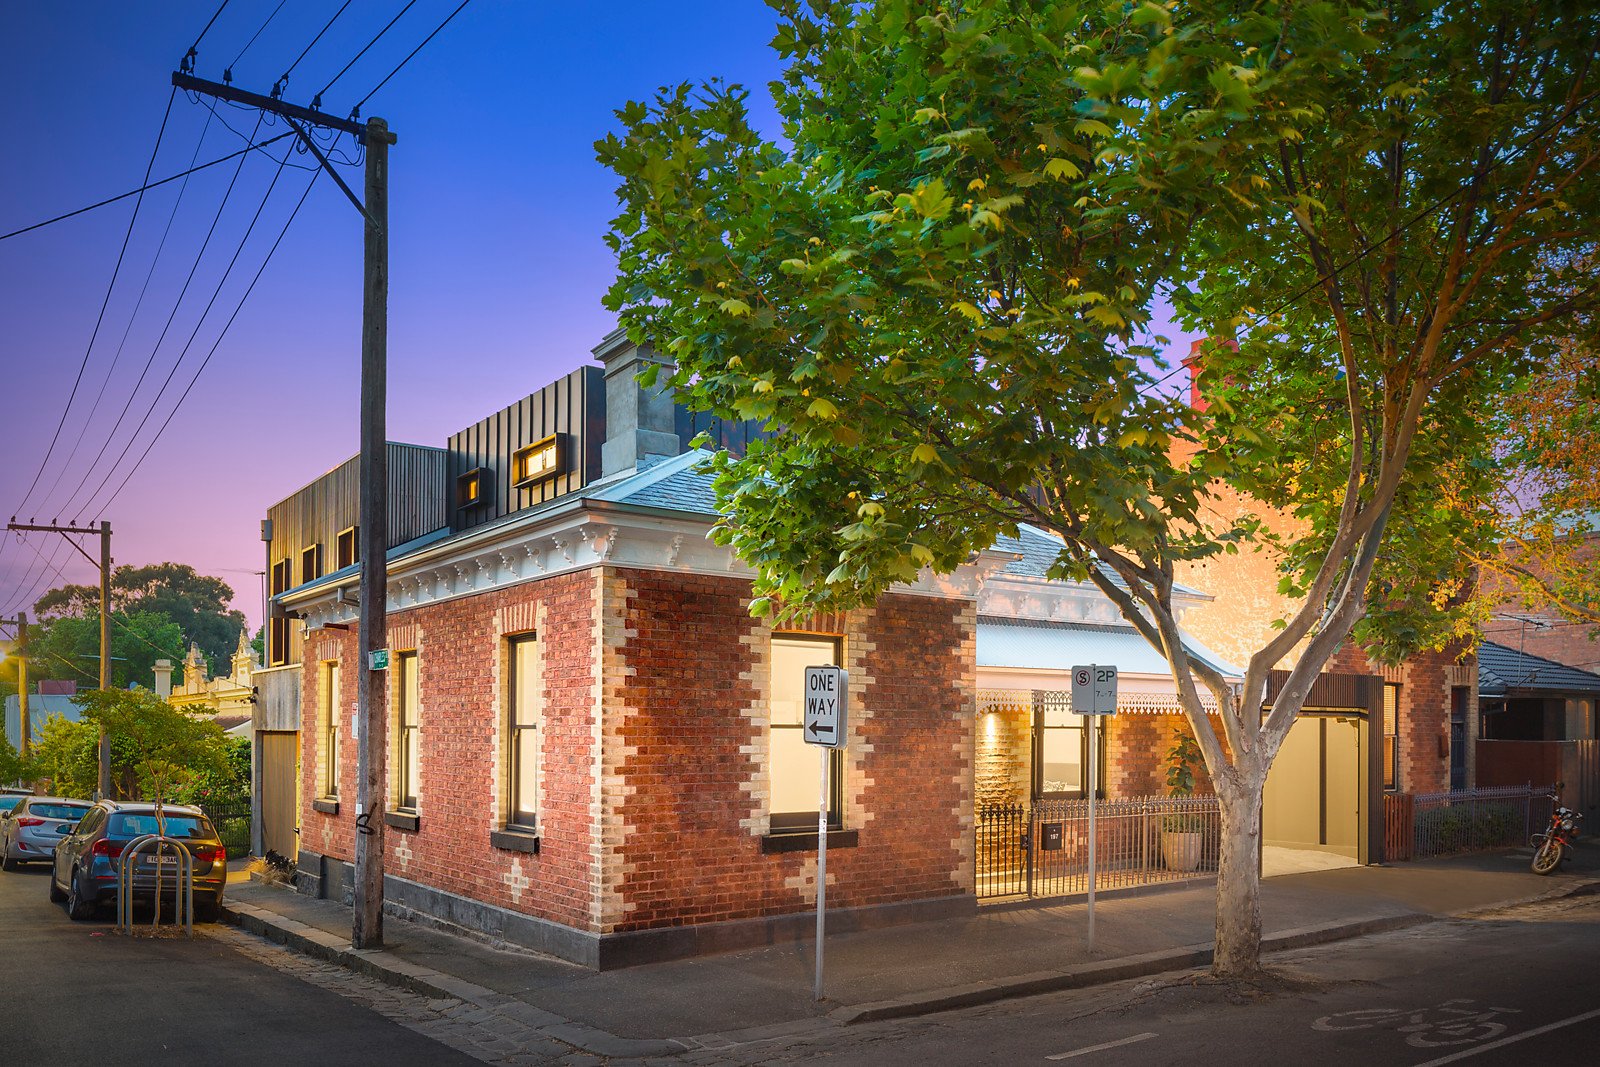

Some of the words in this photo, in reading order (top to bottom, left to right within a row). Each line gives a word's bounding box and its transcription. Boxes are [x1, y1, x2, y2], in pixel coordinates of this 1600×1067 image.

[811, 674, 834, 691] ONE
[1096, 670, 1115, 682] 2P
[808, 697, 835, 715] WAY
